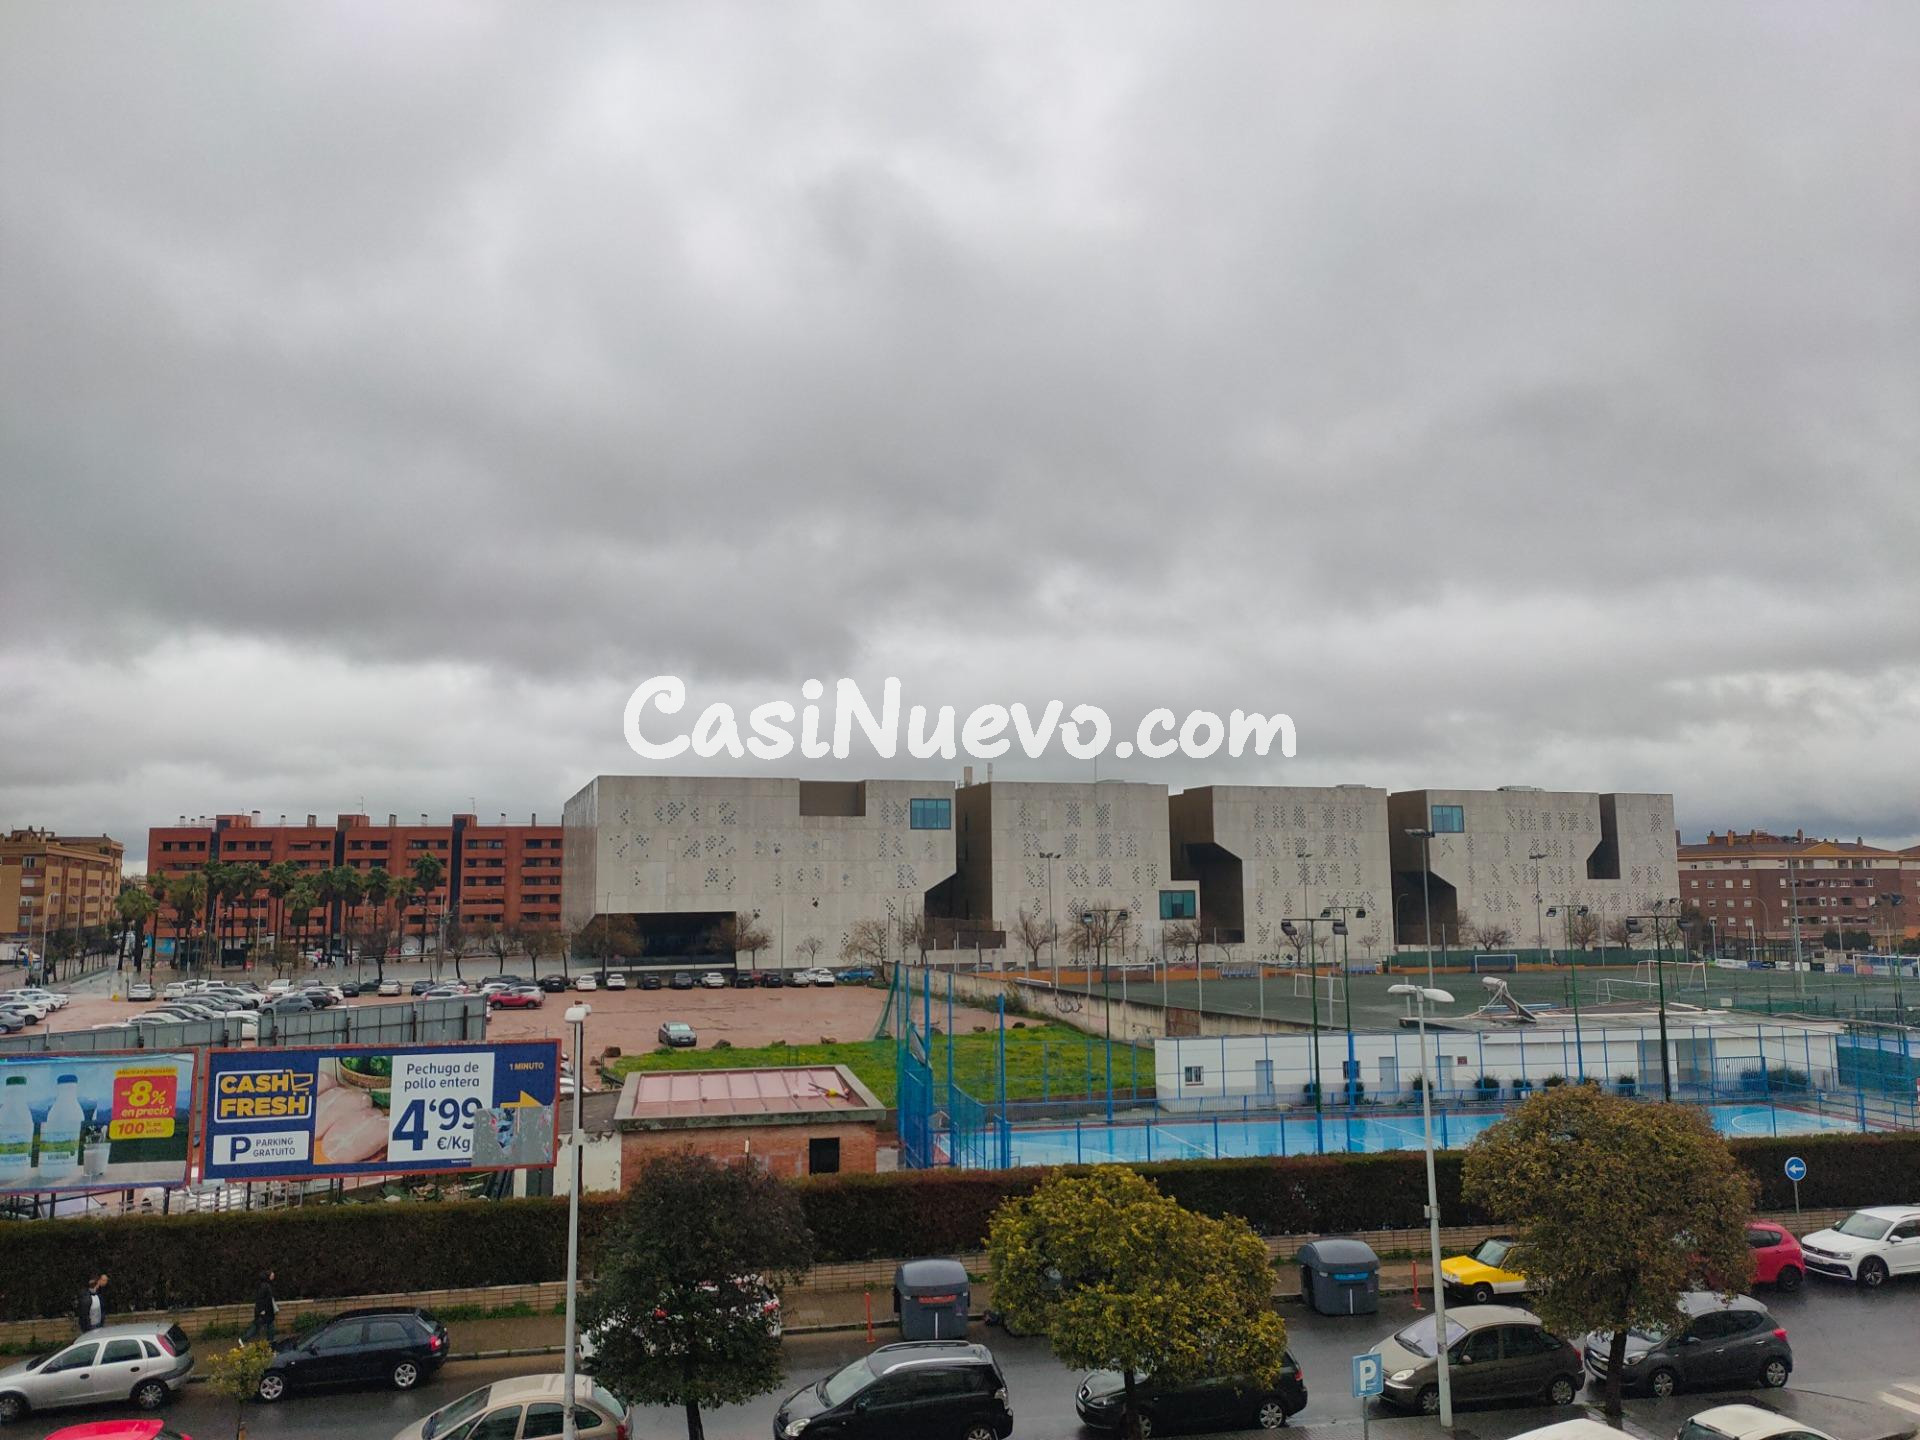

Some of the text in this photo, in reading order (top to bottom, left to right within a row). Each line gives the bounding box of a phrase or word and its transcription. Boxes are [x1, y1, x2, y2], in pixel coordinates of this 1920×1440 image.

[406, 1062, 480, 1076] Pechuga de
[509, 1062, 545, 1071] 1 MINUTO
[220, 1074, 290, 1094] CASH
[404, 1077, 480, 1092] pollo entera
[121, 1109, 135, 1117] en
[220, 1096, 306, 1118] FRESH
[119, 1122, 144, 1135] 100
[230, 1136, 252, 1162] P
[256, 1138, 294, 1147] PARKING
[437, 1136, 471, 1152] €/Kg
[252, 1147, 296, 1157] GRATUITO
[1360, 1359, 1377, 1391] P
